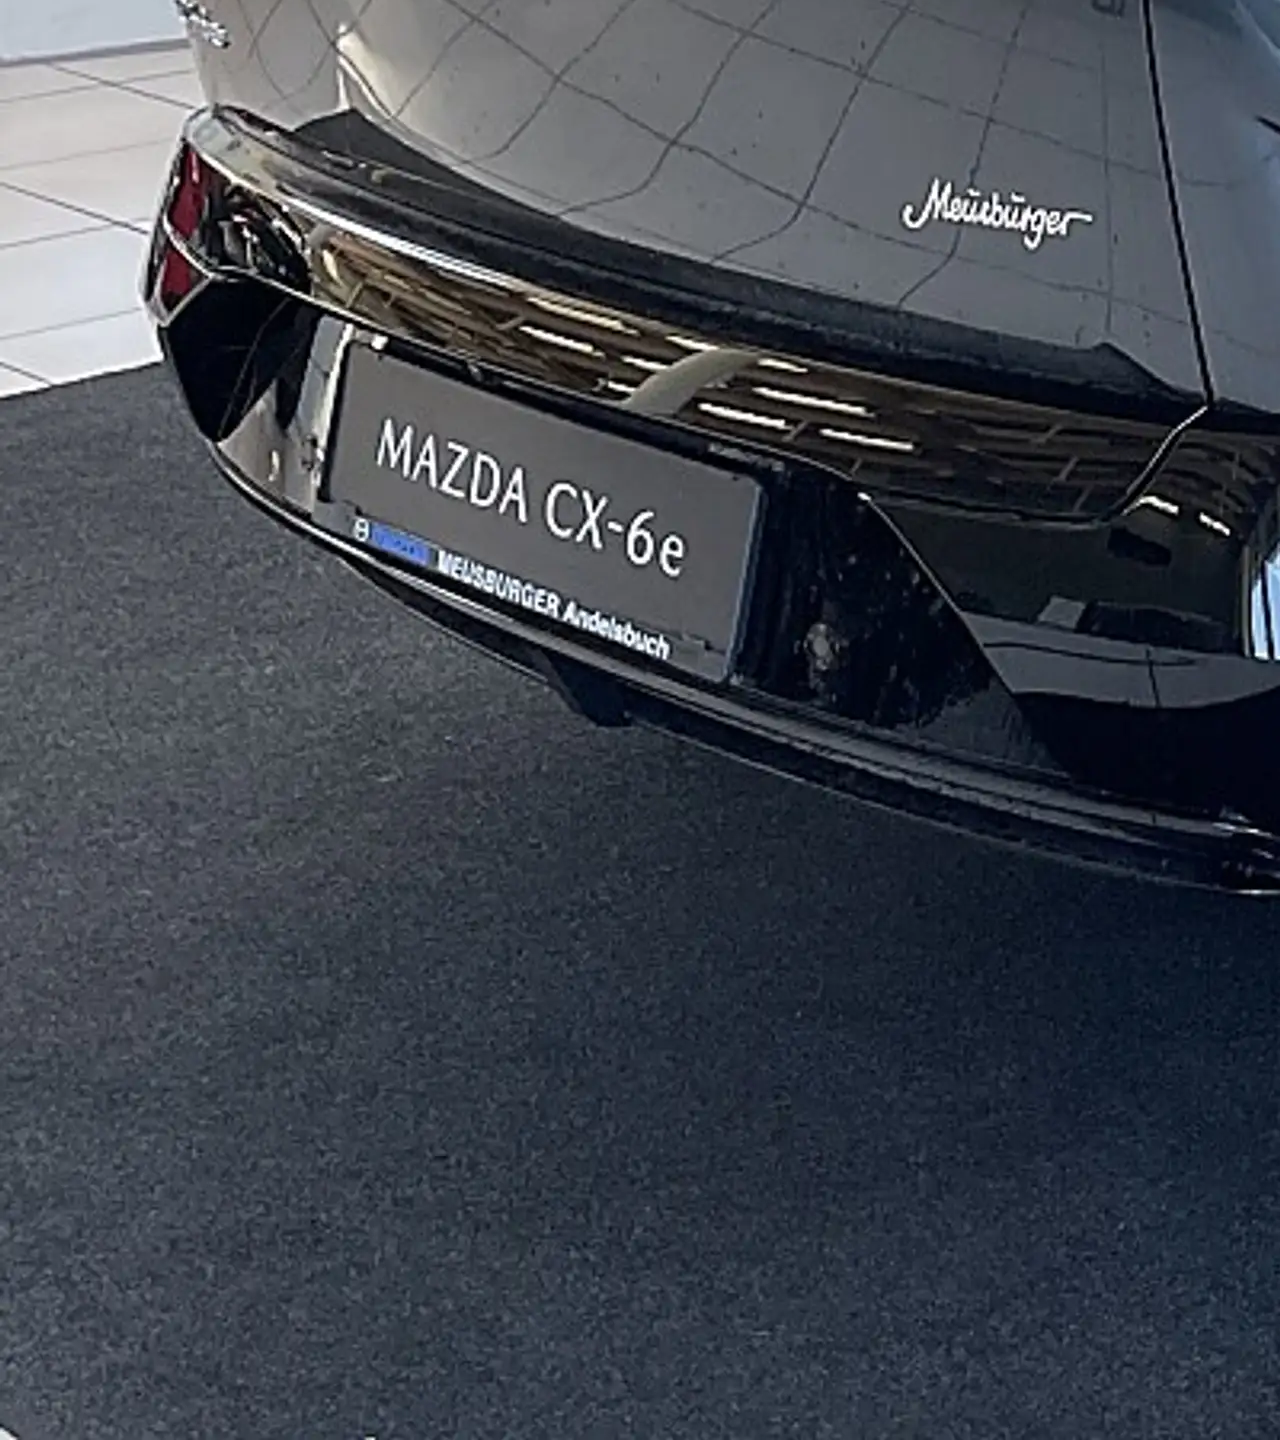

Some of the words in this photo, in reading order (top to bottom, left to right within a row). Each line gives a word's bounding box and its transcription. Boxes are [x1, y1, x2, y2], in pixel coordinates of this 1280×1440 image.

[377, 417, 528, 523] MAZDA
[546, 482, 686, 578] CX-6e
[437, 549, 560, 619] MEUSBURGER
[562, 600, 671, 661] Andelsbuch
